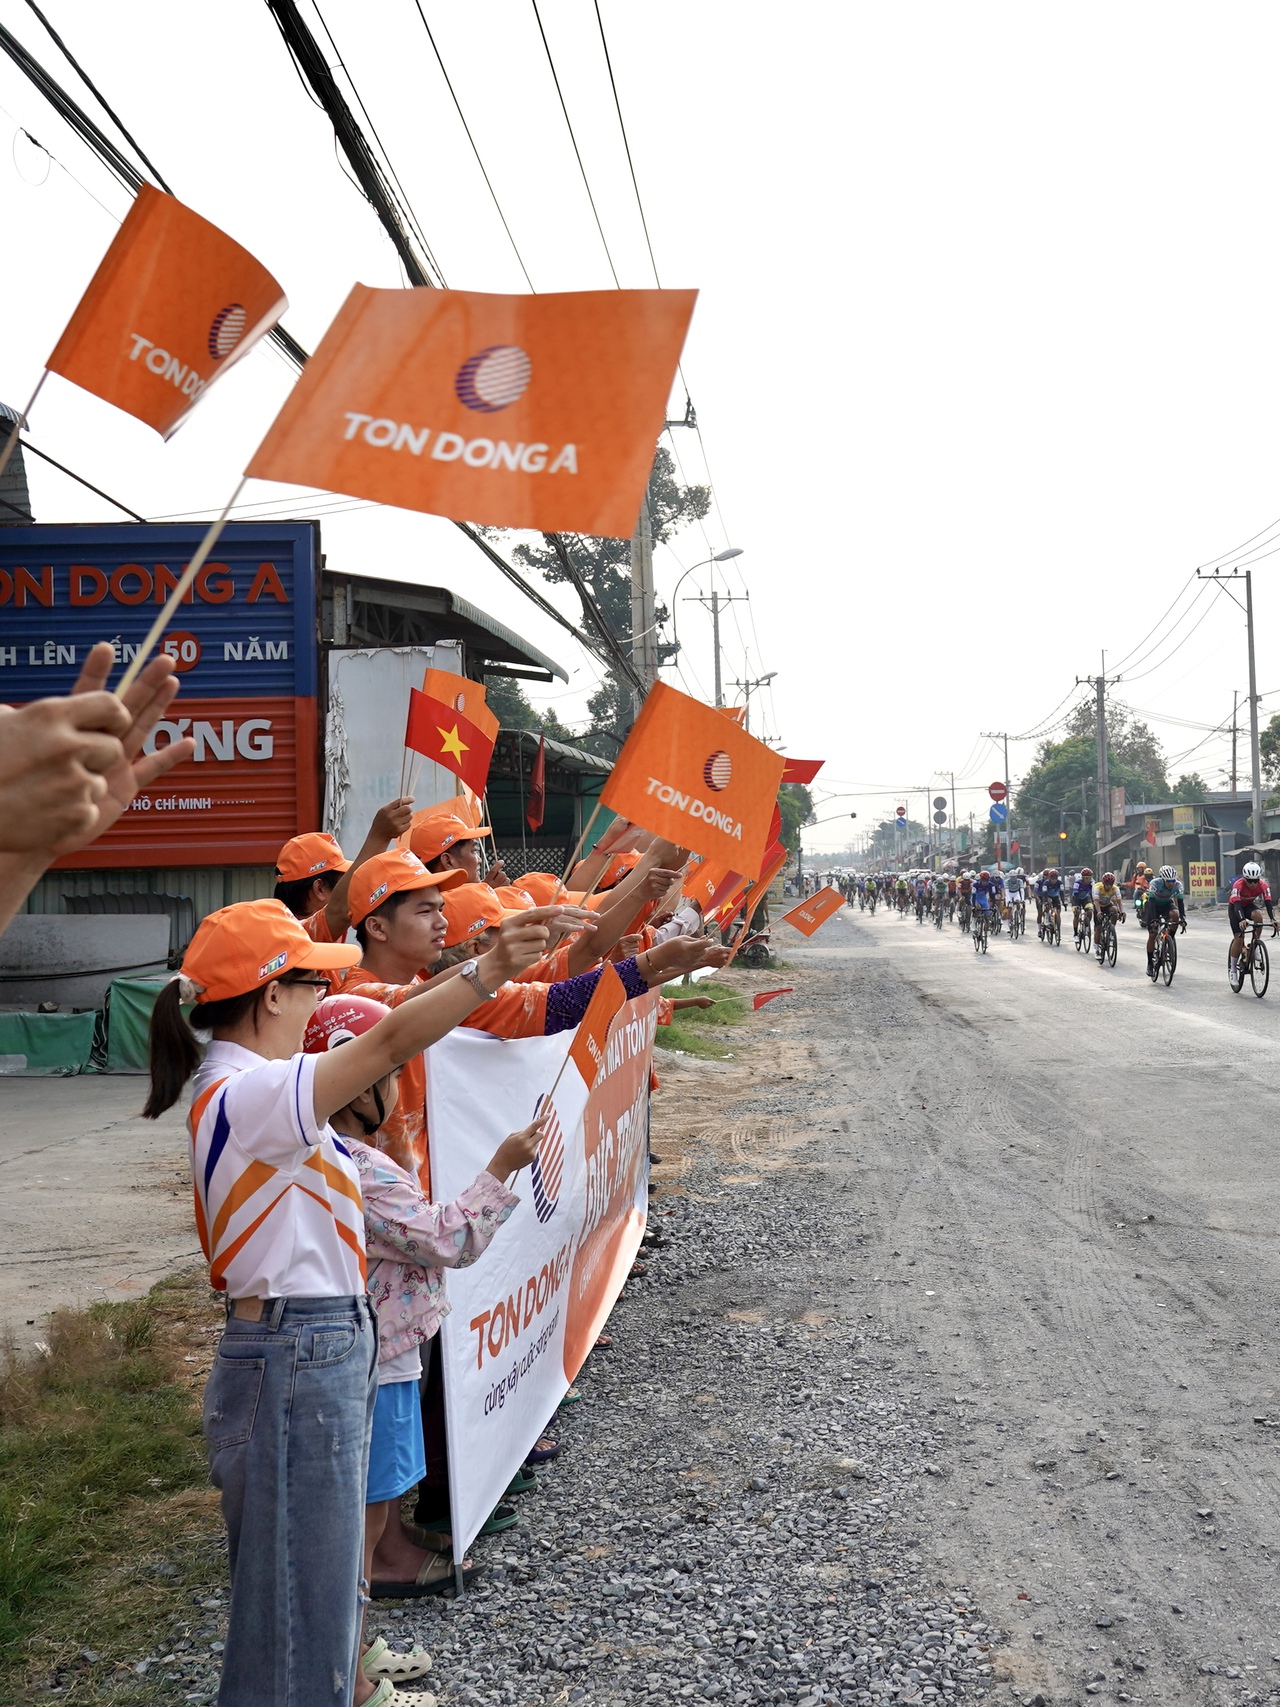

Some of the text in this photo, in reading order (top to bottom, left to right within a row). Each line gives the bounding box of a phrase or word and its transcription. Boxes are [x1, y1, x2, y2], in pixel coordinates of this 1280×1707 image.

[129, 333, 189, 387] TON
[343, 411, 579, 474] TON DONG A
[69, 562, 235, 606] DONG
[245, 562, 290, 602] A
[28, 641, 76, 665] LÊN
[94, 635, 143, 664] ẾN
[163, 640, 198, 662] 50
[223, 636, 288, 661] NĂM
[132, 795, 151, 811] HỒ
[155, 795, 175, 811] CHÍ
[178, 797, 212, 810] MINH
[647, 777, 743, 841] TON DONG A
[370, 884, 387, 904] HTV
[468, 918, 486, 933] HTV
[259, 952, 287, 978] HTV
[626, 1011, 646, 1060] TÔN
[470, 1286, 523, 1370] TON
[523, 1243, 567, 1330] DONG
[484, 1377, 507, 1416] cùng
[505, 1361, 521, 1394] xây
